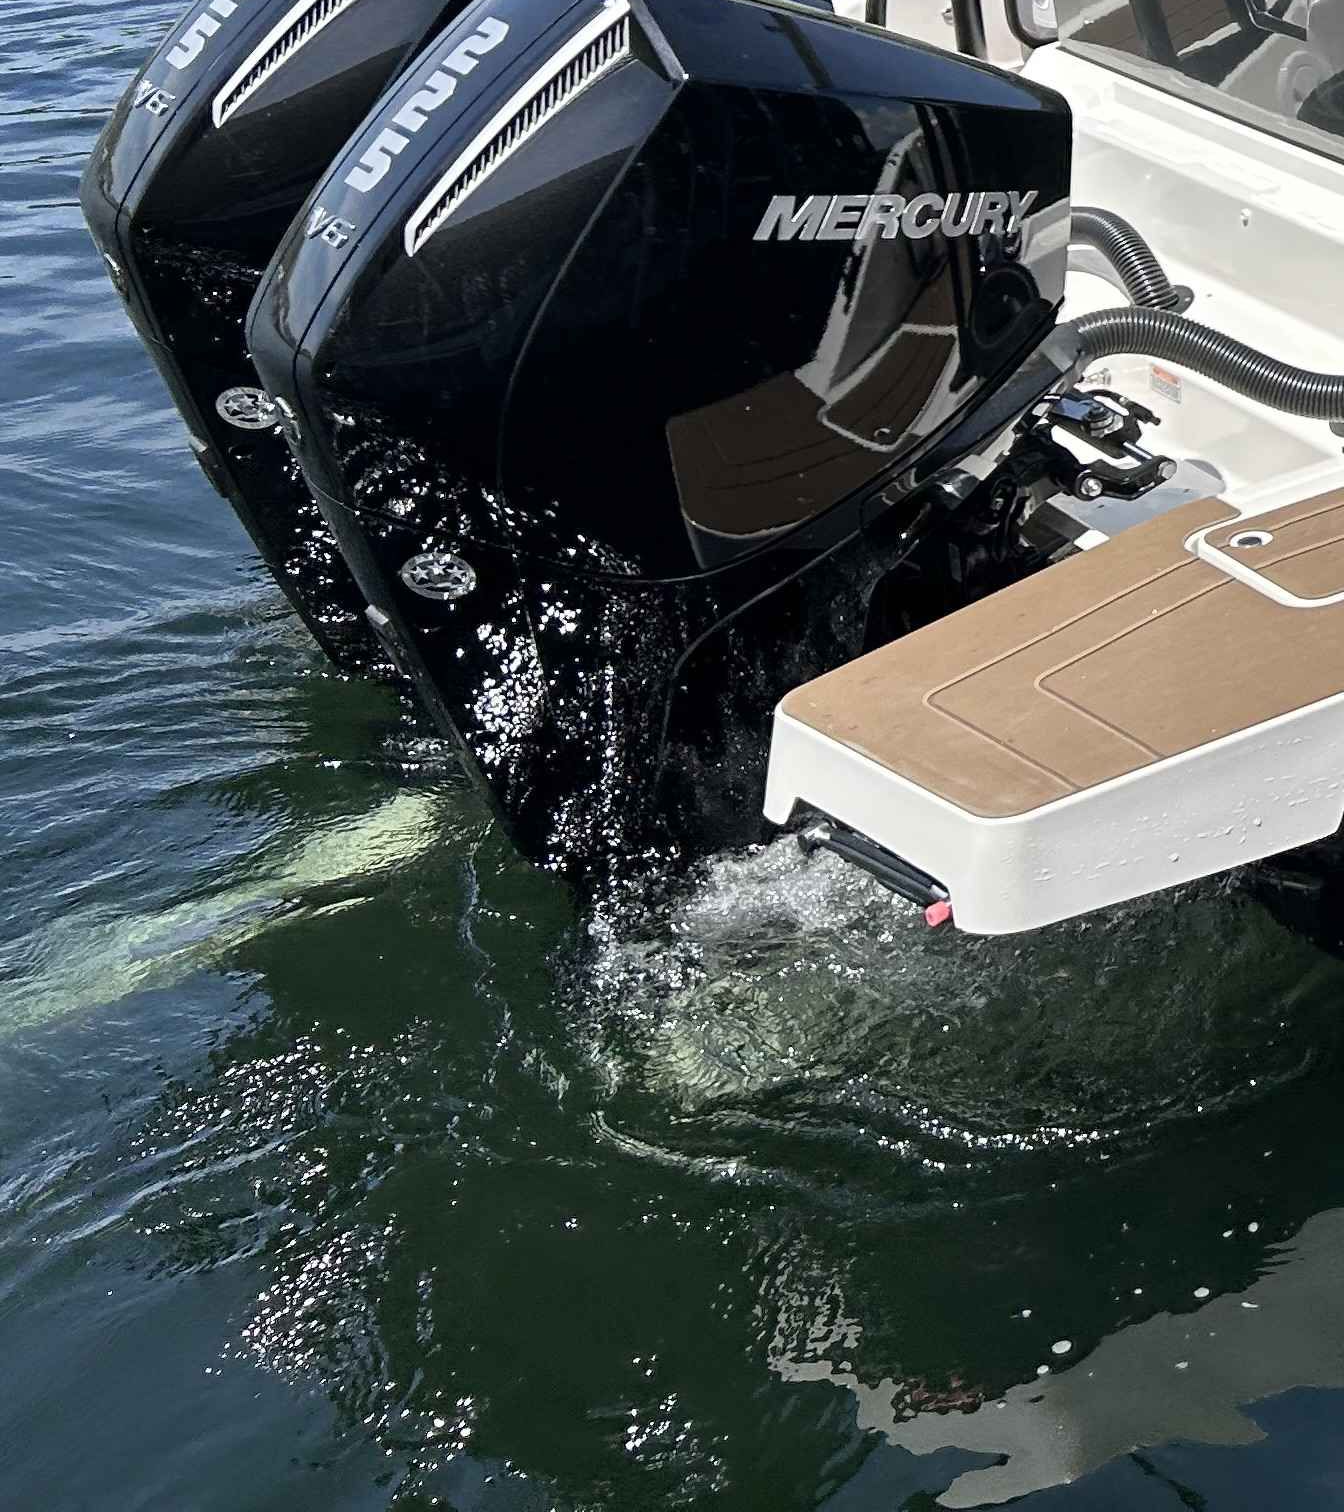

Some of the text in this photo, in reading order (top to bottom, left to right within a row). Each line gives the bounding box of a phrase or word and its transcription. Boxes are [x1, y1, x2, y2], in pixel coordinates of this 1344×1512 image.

[134, 78, 176, 117] V6
[344, 16, 510, 193] 225
[305, 206, 356, 250] V6
[752, 190, 1038, 241] MERCURY
